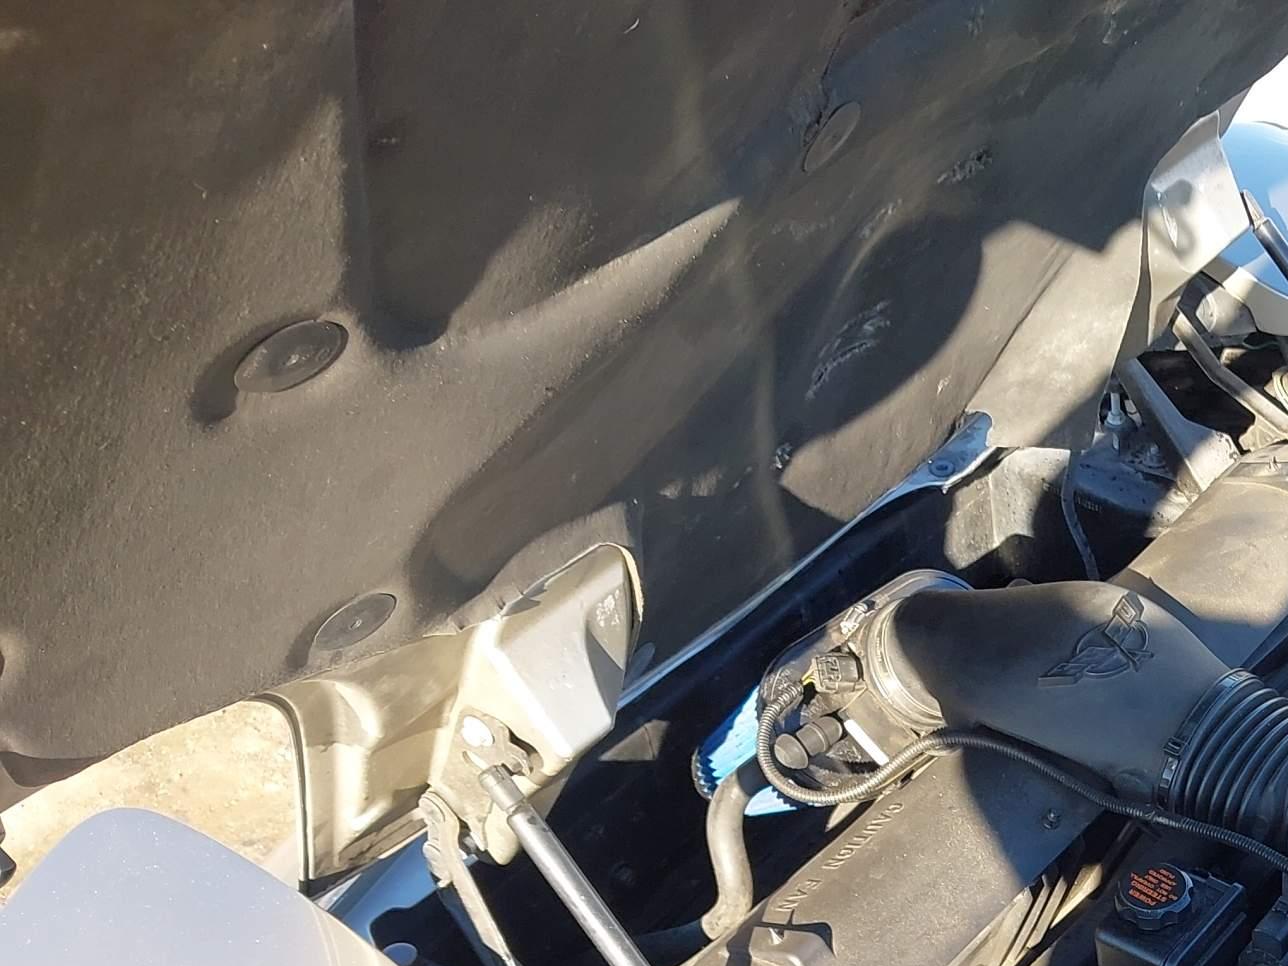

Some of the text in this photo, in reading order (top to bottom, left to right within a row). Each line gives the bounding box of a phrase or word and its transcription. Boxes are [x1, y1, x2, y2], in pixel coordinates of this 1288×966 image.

[775, 803, 904, 912] CAUTION FAN
[1128, 888, 1156, 906] POWER
[1130, 879, 1167, 902] STEERING
